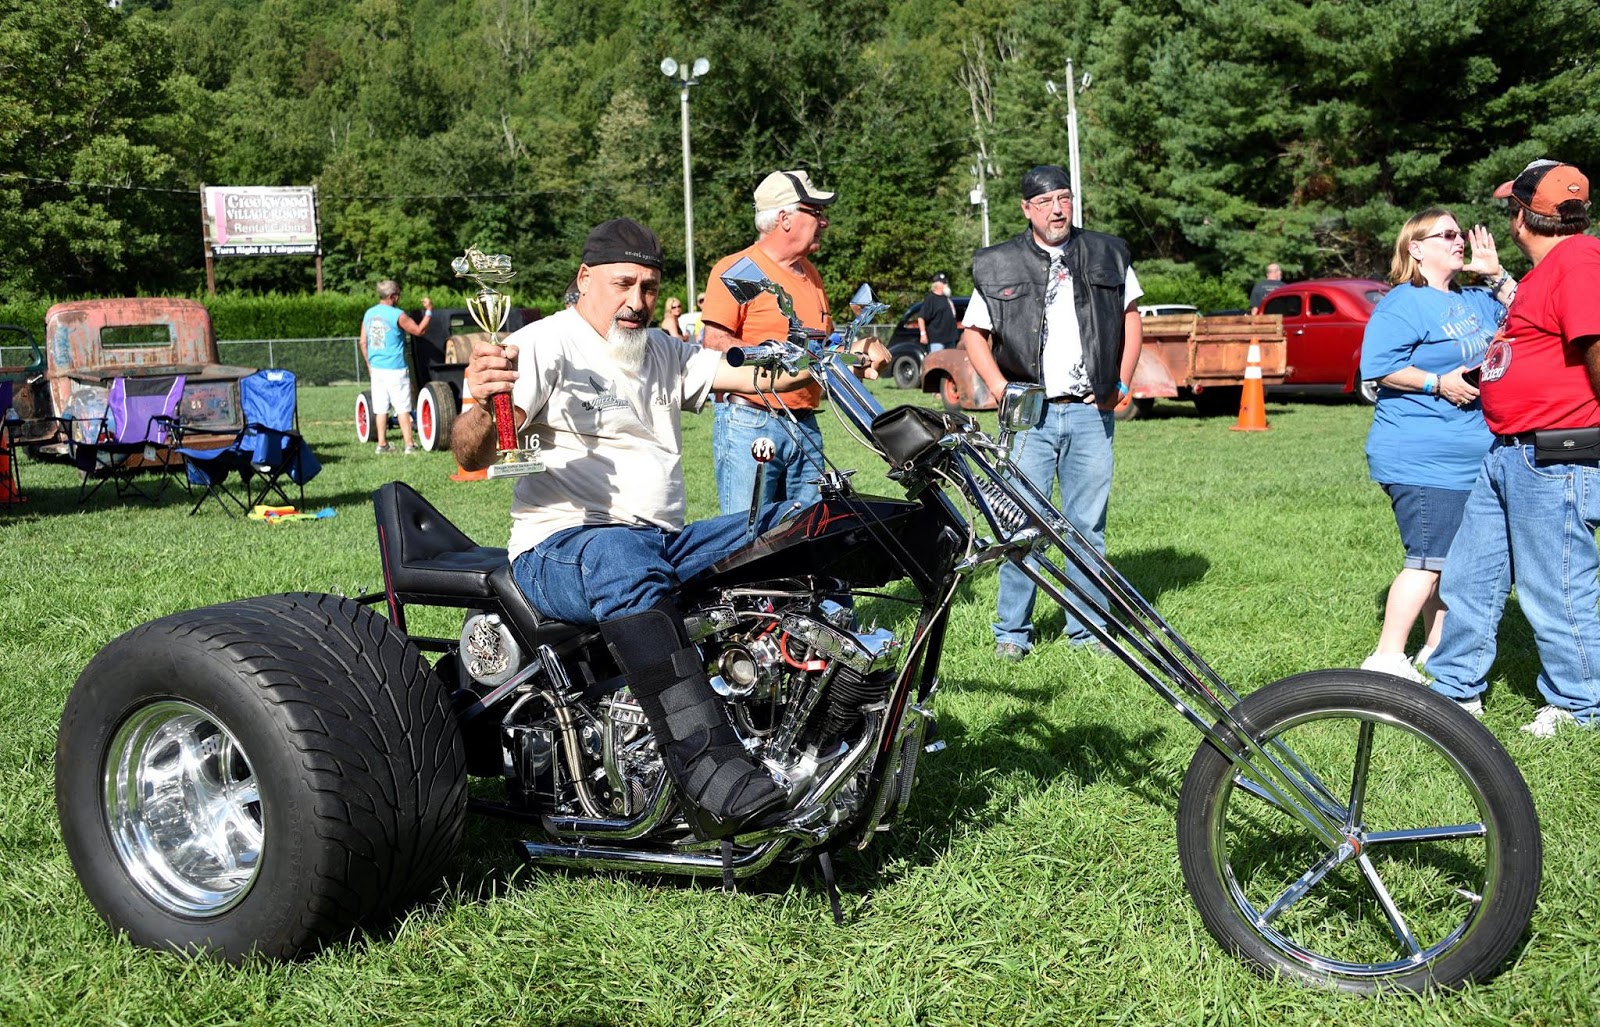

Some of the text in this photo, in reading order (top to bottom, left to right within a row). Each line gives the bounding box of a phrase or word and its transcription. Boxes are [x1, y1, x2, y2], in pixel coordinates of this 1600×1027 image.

[228, 195, 308, 208] Creekwood
[227, 208, 309, 220] VILLAGE RESORT
[234, 222, 306, 233] Rental Cabins
[236, 246, 258, 255] Right
[259, 245, 270, 253] At
[524, 433, 540, 450] 16
